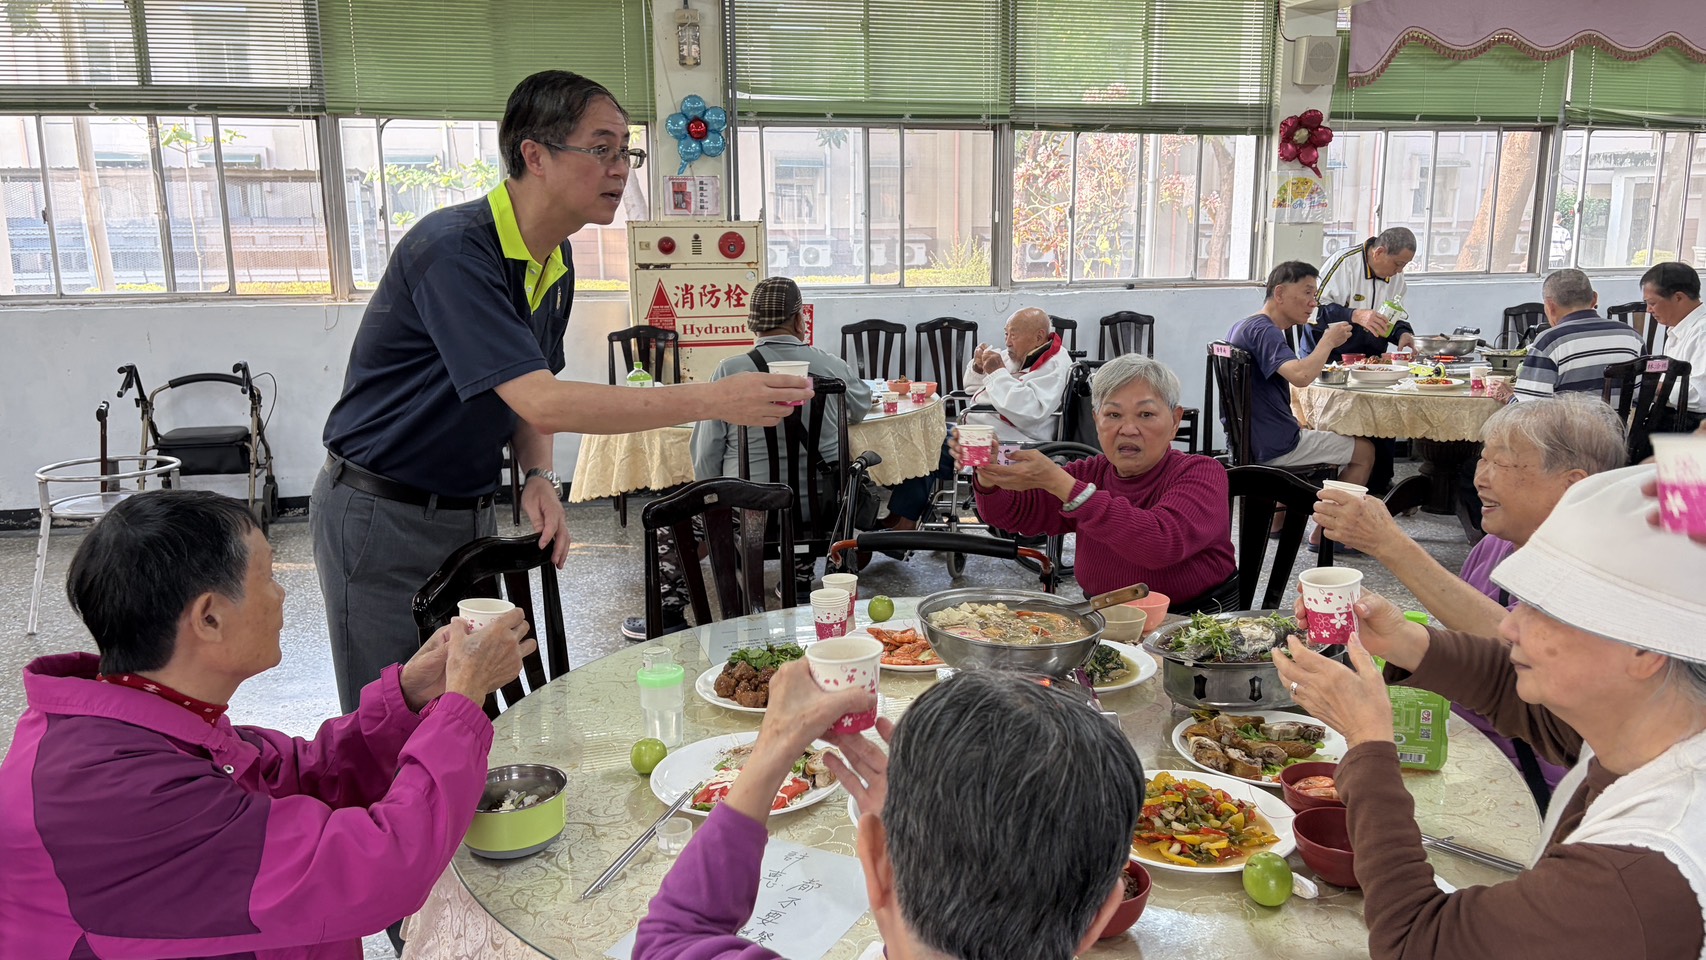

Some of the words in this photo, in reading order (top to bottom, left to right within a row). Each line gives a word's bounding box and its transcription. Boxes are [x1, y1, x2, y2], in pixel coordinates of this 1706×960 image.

[674, 282, 749, 310] 消防栓
[682, 323, 746, 337] Hydrant
